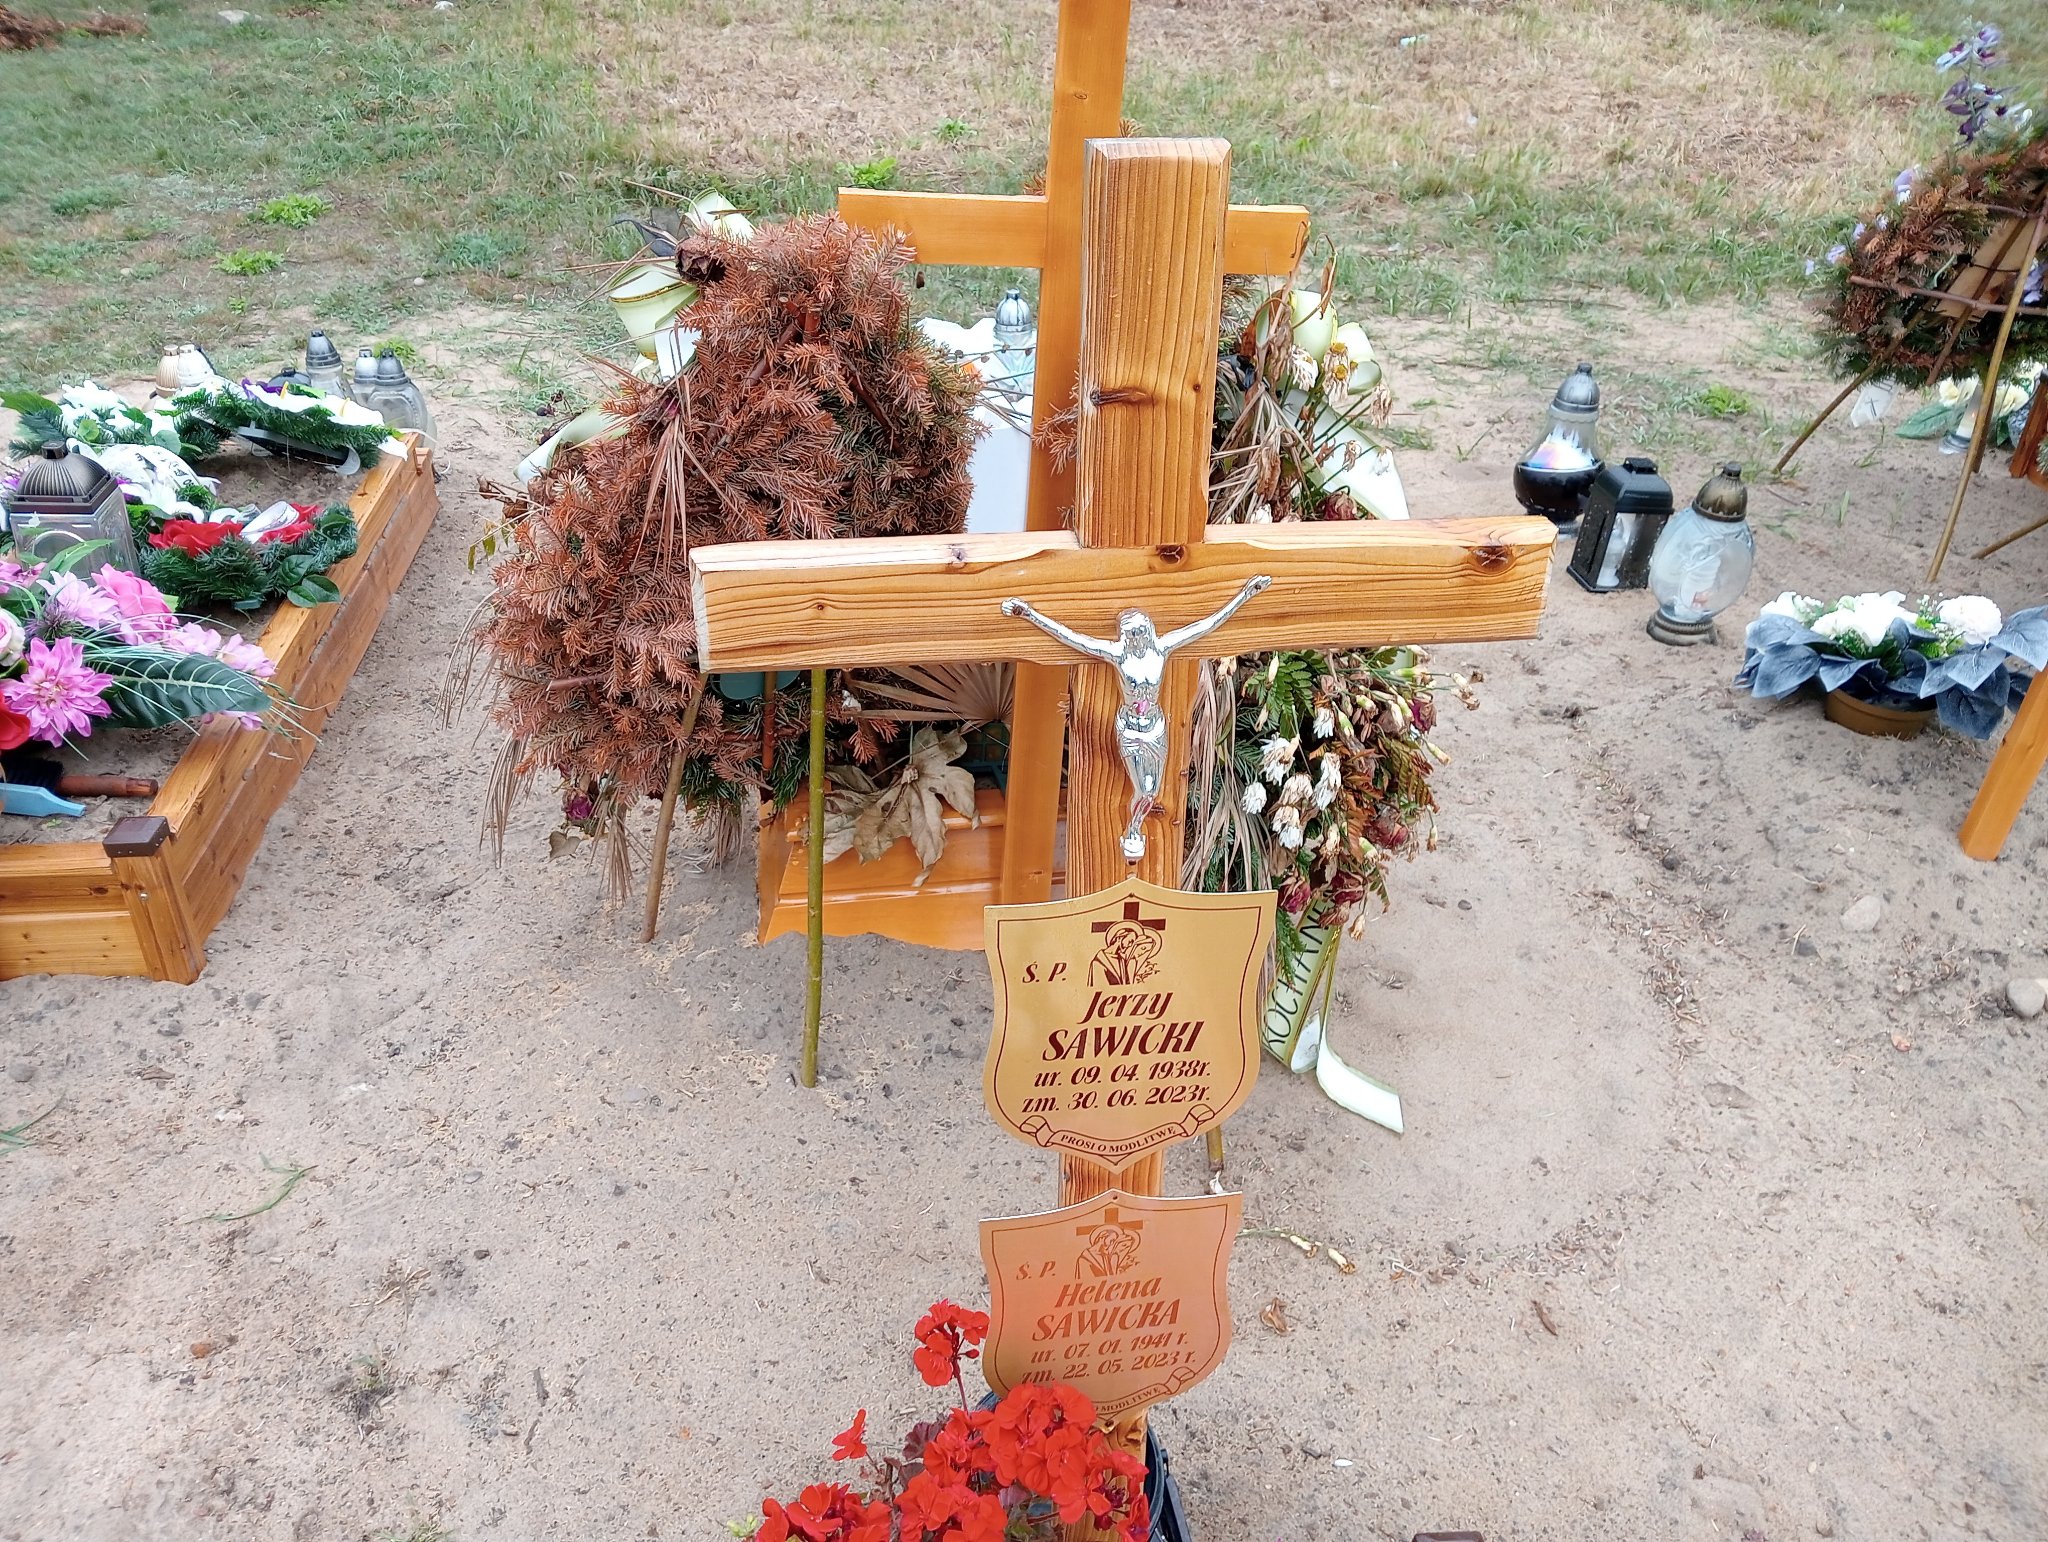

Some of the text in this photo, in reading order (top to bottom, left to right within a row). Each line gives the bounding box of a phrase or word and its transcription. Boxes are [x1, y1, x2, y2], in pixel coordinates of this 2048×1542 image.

[1022, 961, 1067, 983] Ś. P.
[1077, 991, 1173, 1024] Jerzy
[1042, 1021, 1204, 1061] SAWICKI
[1034, 1060, 1210, 1087] ur. 09. 04. 1938r.
[1021, 1084, 1210, 1112] zm. 30. 06. 2023r.
[1061, 1126, 1176, 1153] PROSI O MODLITWĘ
[1016, 1260, 1056, 1281] Ś. P.
[1054, 1277, 1162, 1308] Helena
[1032, 1298, 1180, 1342] SAWICKA
[1031, 1331, 1188, 1364] ur. 07. 01. 1941 r.
[1021, 1350, 1196, 1384] zm. 22. 05. 2023 r.
